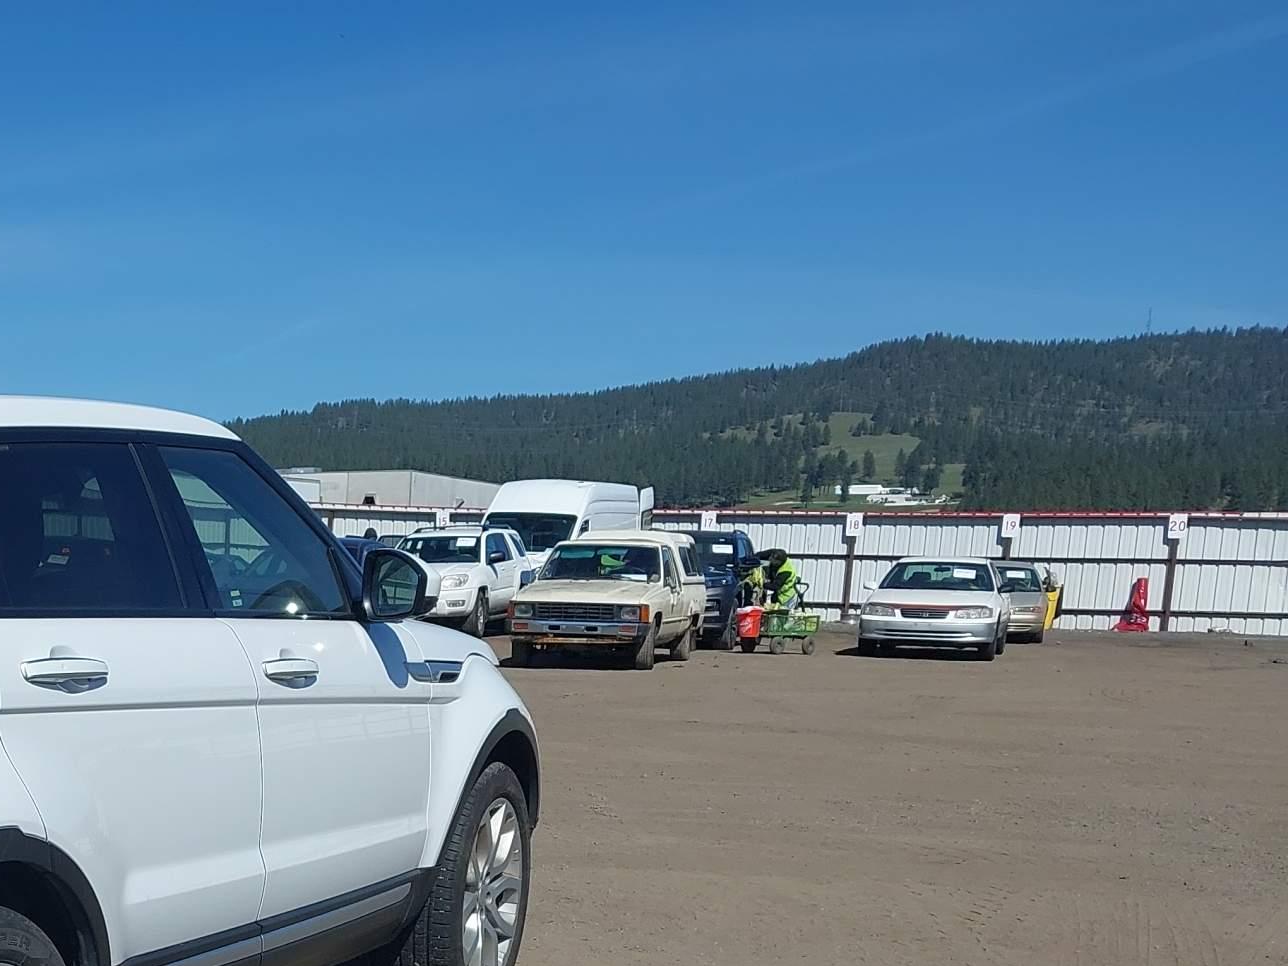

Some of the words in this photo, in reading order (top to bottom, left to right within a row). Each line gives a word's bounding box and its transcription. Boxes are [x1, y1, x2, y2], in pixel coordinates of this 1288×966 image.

[704, 518, 713, 528] 17
[849, 519, 860, 530] 18
[1006, 520, 1017, 531] 19
[1170, 520, 1186, 532] 20
